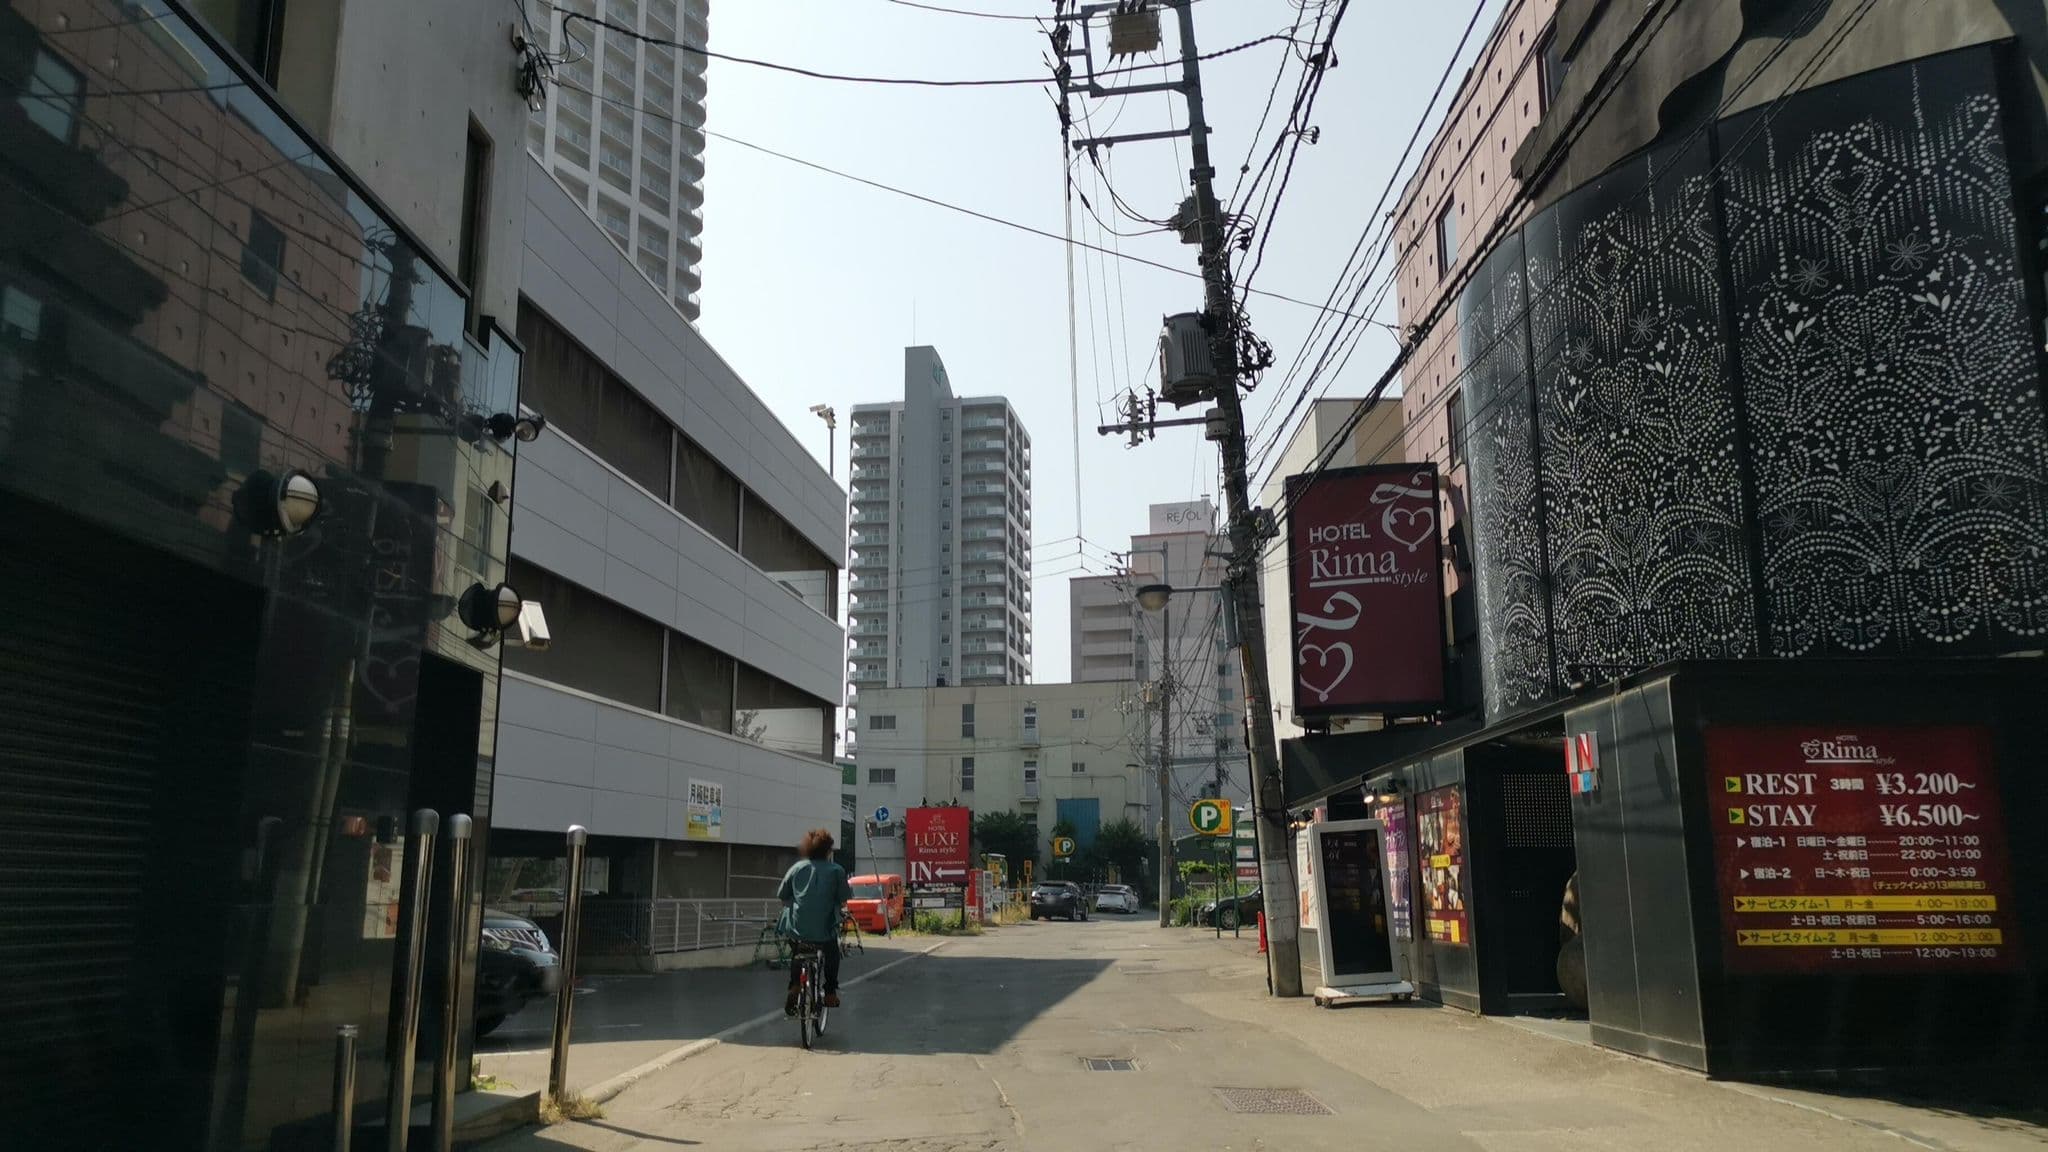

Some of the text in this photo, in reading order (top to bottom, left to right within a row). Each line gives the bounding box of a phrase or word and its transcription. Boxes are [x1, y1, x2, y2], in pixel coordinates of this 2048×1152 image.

[1166, 508, 1202, 525] RESOL
[1309, 523, 1371, 544] HOTEL
[1310, 546, 1429, 588] Rima style
[1822, 741, 1878, 759] Rima
[1745, 773, 1818, 795] REST
[1200, 806, 1218, 828] P
[1748, 804, 1818, 827] STAY
[914, 832, 960, 847] LUXE
[1062, 841, 1072, 852] P
[910, 860, 934, 881] IN
